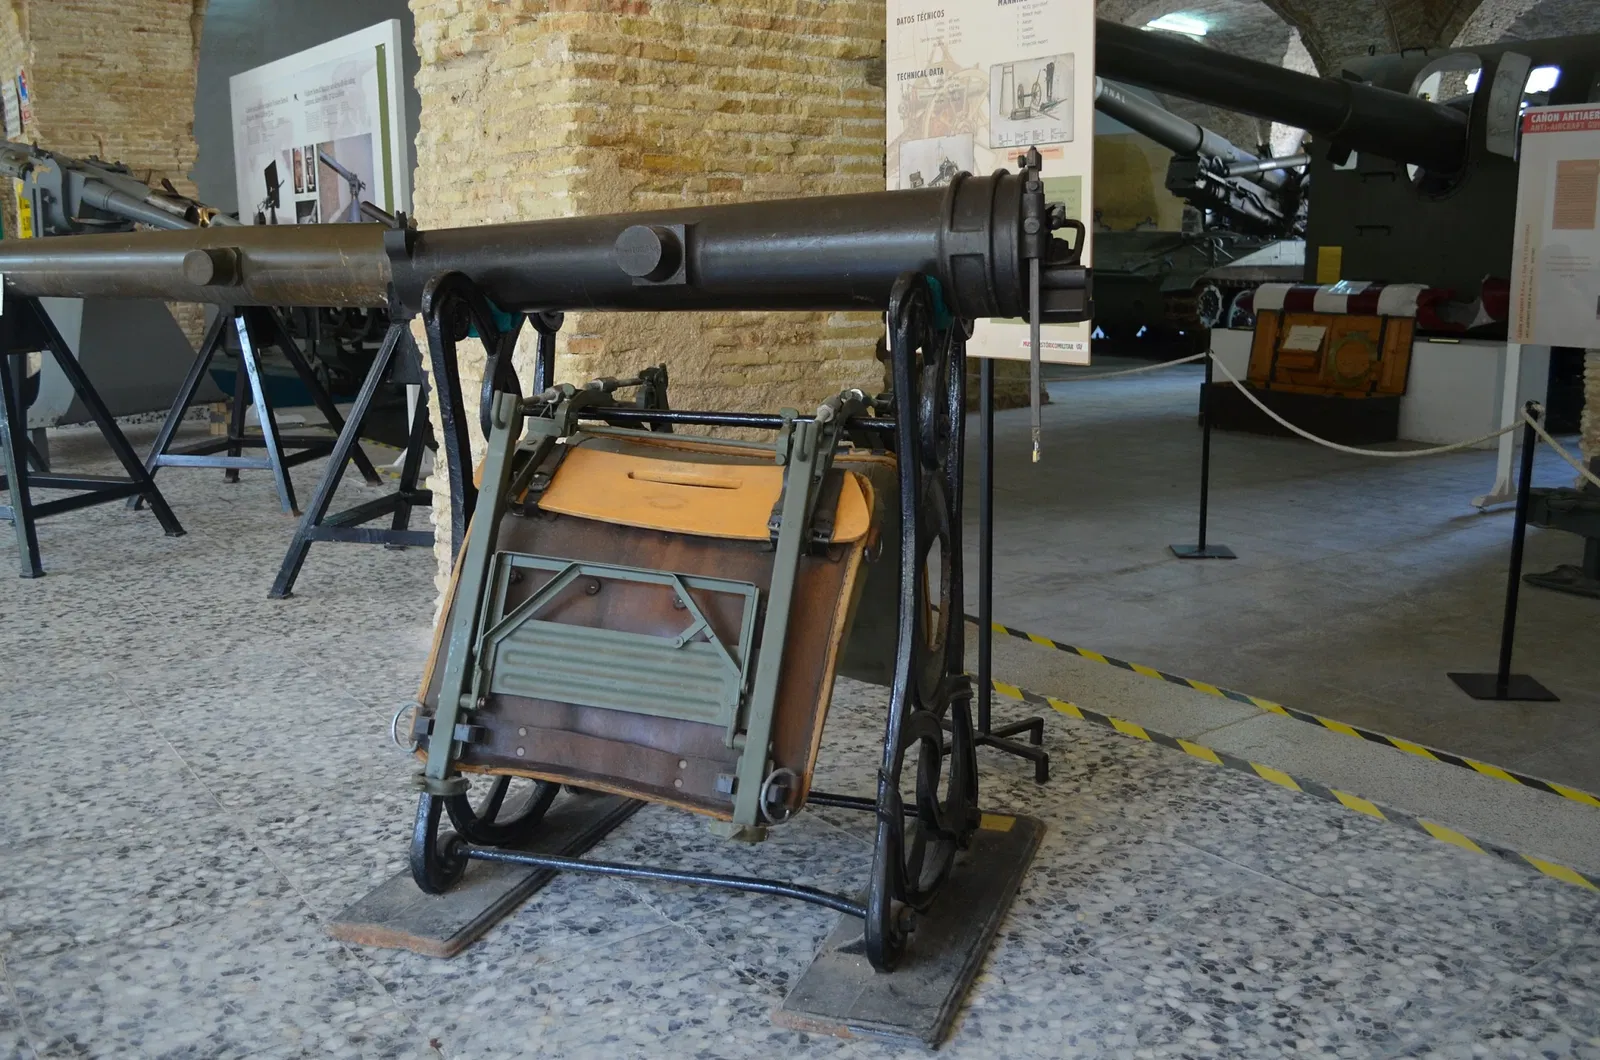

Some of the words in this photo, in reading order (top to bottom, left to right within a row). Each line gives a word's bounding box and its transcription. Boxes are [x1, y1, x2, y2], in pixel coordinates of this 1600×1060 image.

[896, 15, 915, 26] DATOS
[917, 9, 945, 22] TÉCNICOS
[896, 69, 928, 81] TECHNICAL
[929, 67, 944, 77] DATA
[1531, 112, 1560, 123] CAÑON
